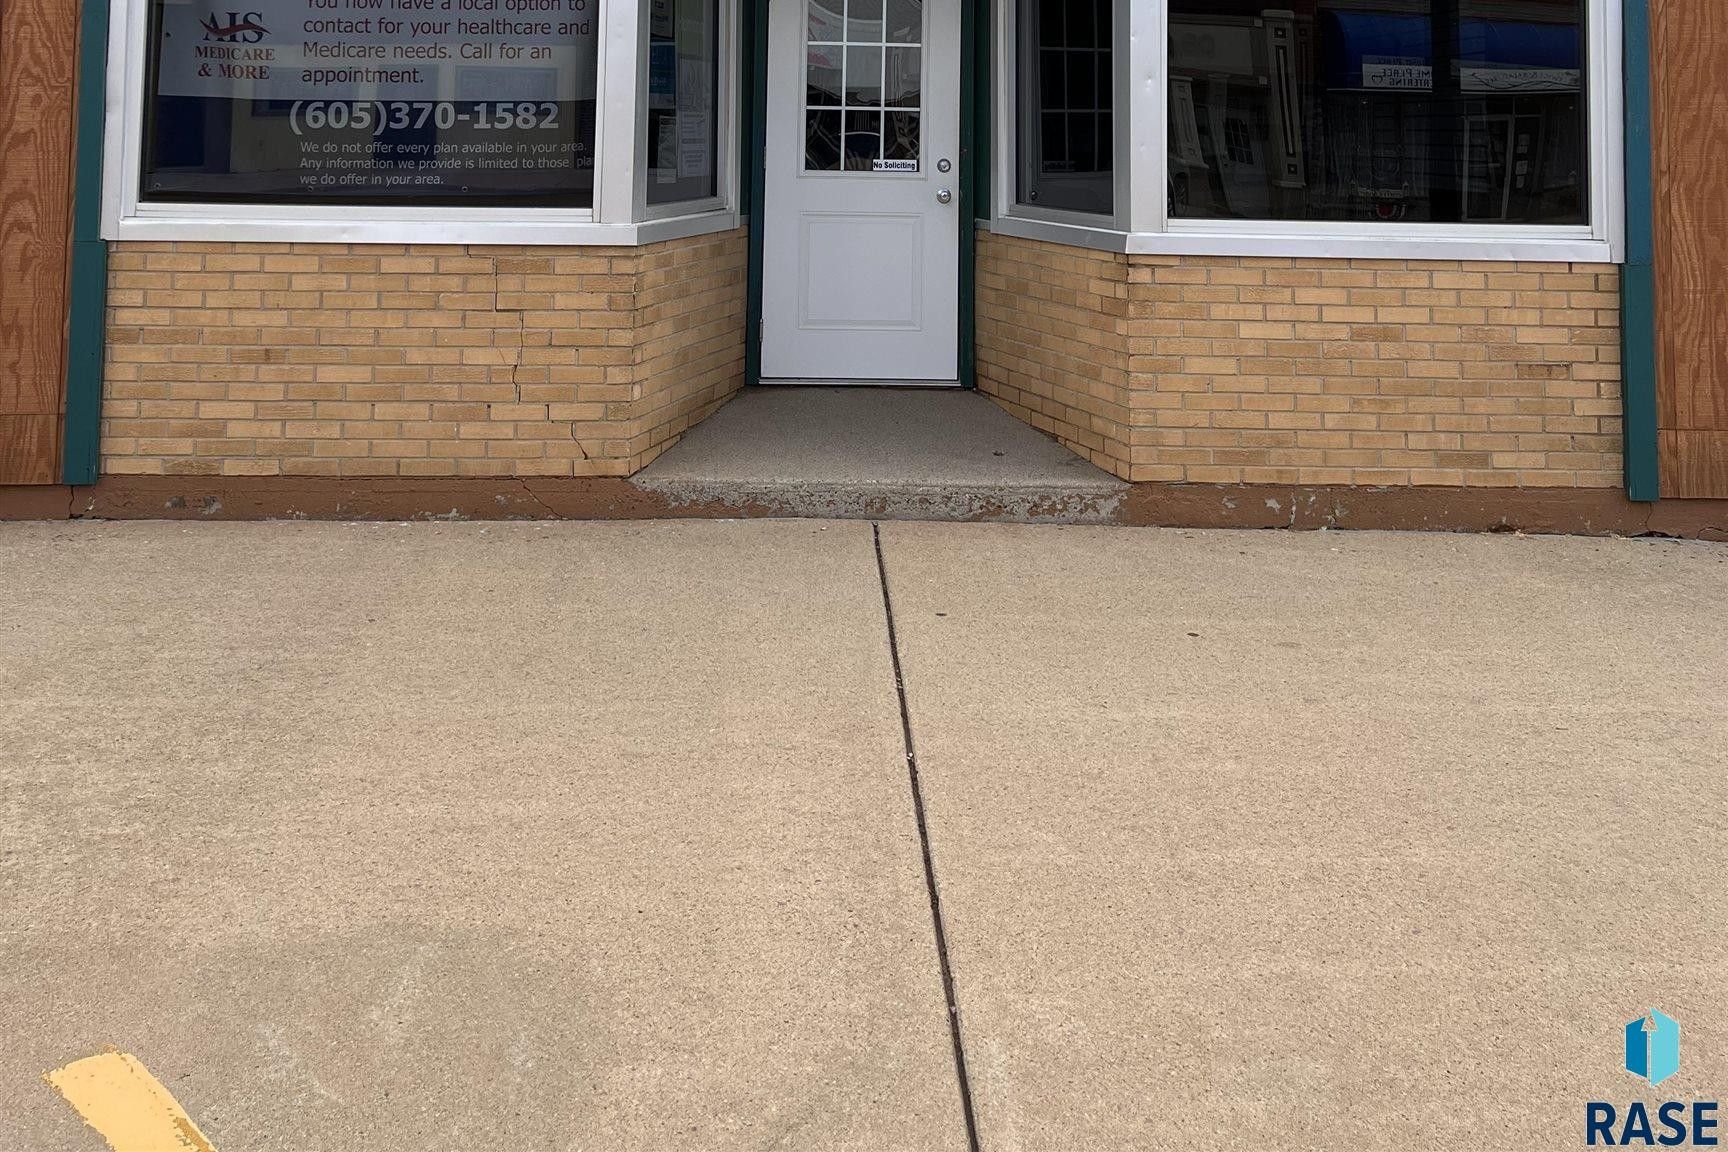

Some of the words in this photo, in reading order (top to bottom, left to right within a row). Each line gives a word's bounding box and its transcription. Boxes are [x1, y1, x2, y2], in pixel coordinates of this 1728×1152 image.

[202, 11, 264, 43] AIS
[303, 18, 371, 34] contact
[378, 17, 403, 34] for
[410, 21, 451, 38] your
[458, 18, 551, 35] healthcare
[558, 19, 590, 35] and
[195, 46, 275, 61] MEDICARE
[303, 41, 386, 58] Medicare
[393, 42, 452, 59] needs.
[460, 43, 492, 59] Call
[499, 43, 525, 59] for
[530, 46, 552, 59] an
[198, 63, 212, 77] &
[218, 64, 270, 80] MORE
[302, 67, 424, 86] appointment.
[289, 100, 559, 136] (605)370-1582
[300, 141, 319, 153] We
[322, 141, 338, 153] do
[341, 142, 361, 153] not
[365, 141, 393, 153] offer
[396, 143, 430, 155] every
[433, 142, 458, 155] plan
[461, 142, 513, 154] available
[516, 142, 527, 153] in
[530, 143, 557, 155] your
[560, 142, 587, 152] area.
[300, 158, 322, 170] Any
[326, 158, 394, 169] information
[398, 159, 415, 169] we
[418, 158, 462, 171] provide
[465, 158, 475, 169] is
[478, 158, 518, 169] limited
[522, 159, 534, 168] to
[538, 158, 569, 168] those
[884, 161, 916, 171] Soliciting
[300, 174, 317, 185] we
[320, 173, 336, 185] do
[339, 173, 368, 185] offer
[371, 173, 382, 184] in
[386, 174, 412, 187] your
[414, 175, 444, 185] area.
